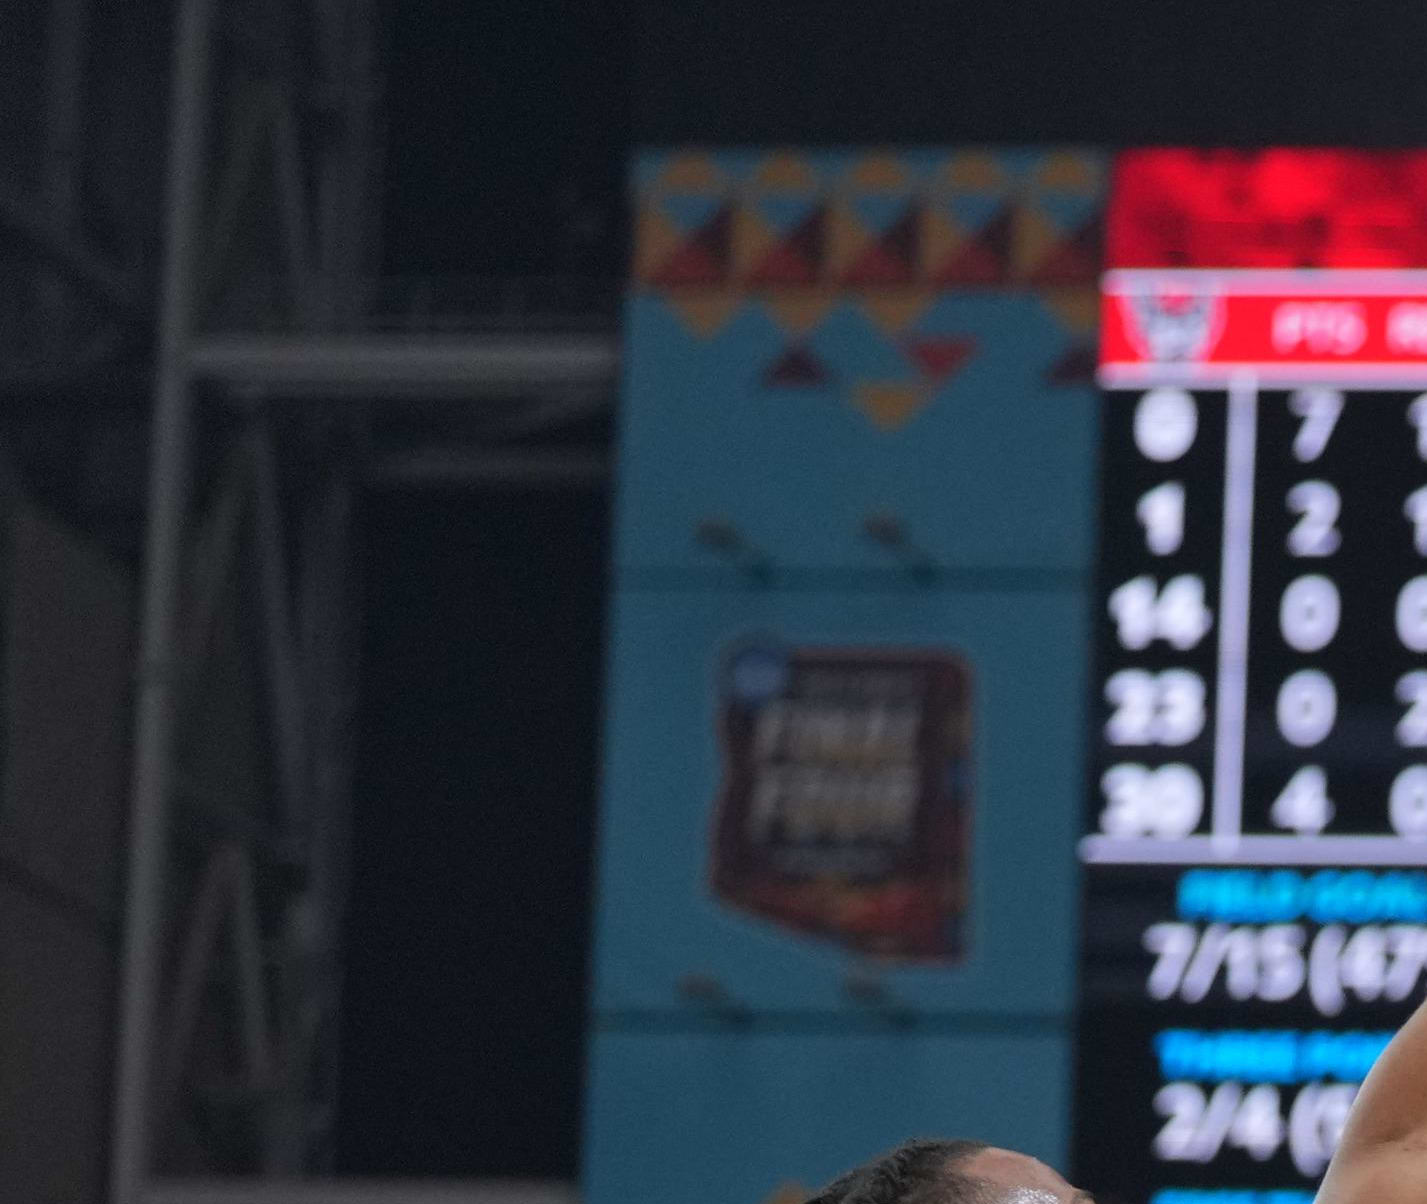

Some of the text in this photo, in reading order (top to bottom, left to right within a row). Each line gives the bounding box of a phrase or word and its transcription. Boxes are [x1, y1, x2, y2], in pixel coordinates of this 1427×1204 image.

[1134, 387, 1198, 463] 0
[1289, 389, 1344, 463] 7
[1136, 481, 1185, 556] 1
[1286, 480, 1342, 557] 2
[1107, 574, 1212, 651] 14
[1280, 573, 1341, 653] 0
[1104, 668, 1206, 746] 23
[1276, 668, 1337, 748] 0
[1101, 762, 1204, 838] 30
[1271, 764, 1334, 836] 4
[1152, 1082, 1285, 1164] 2/4
